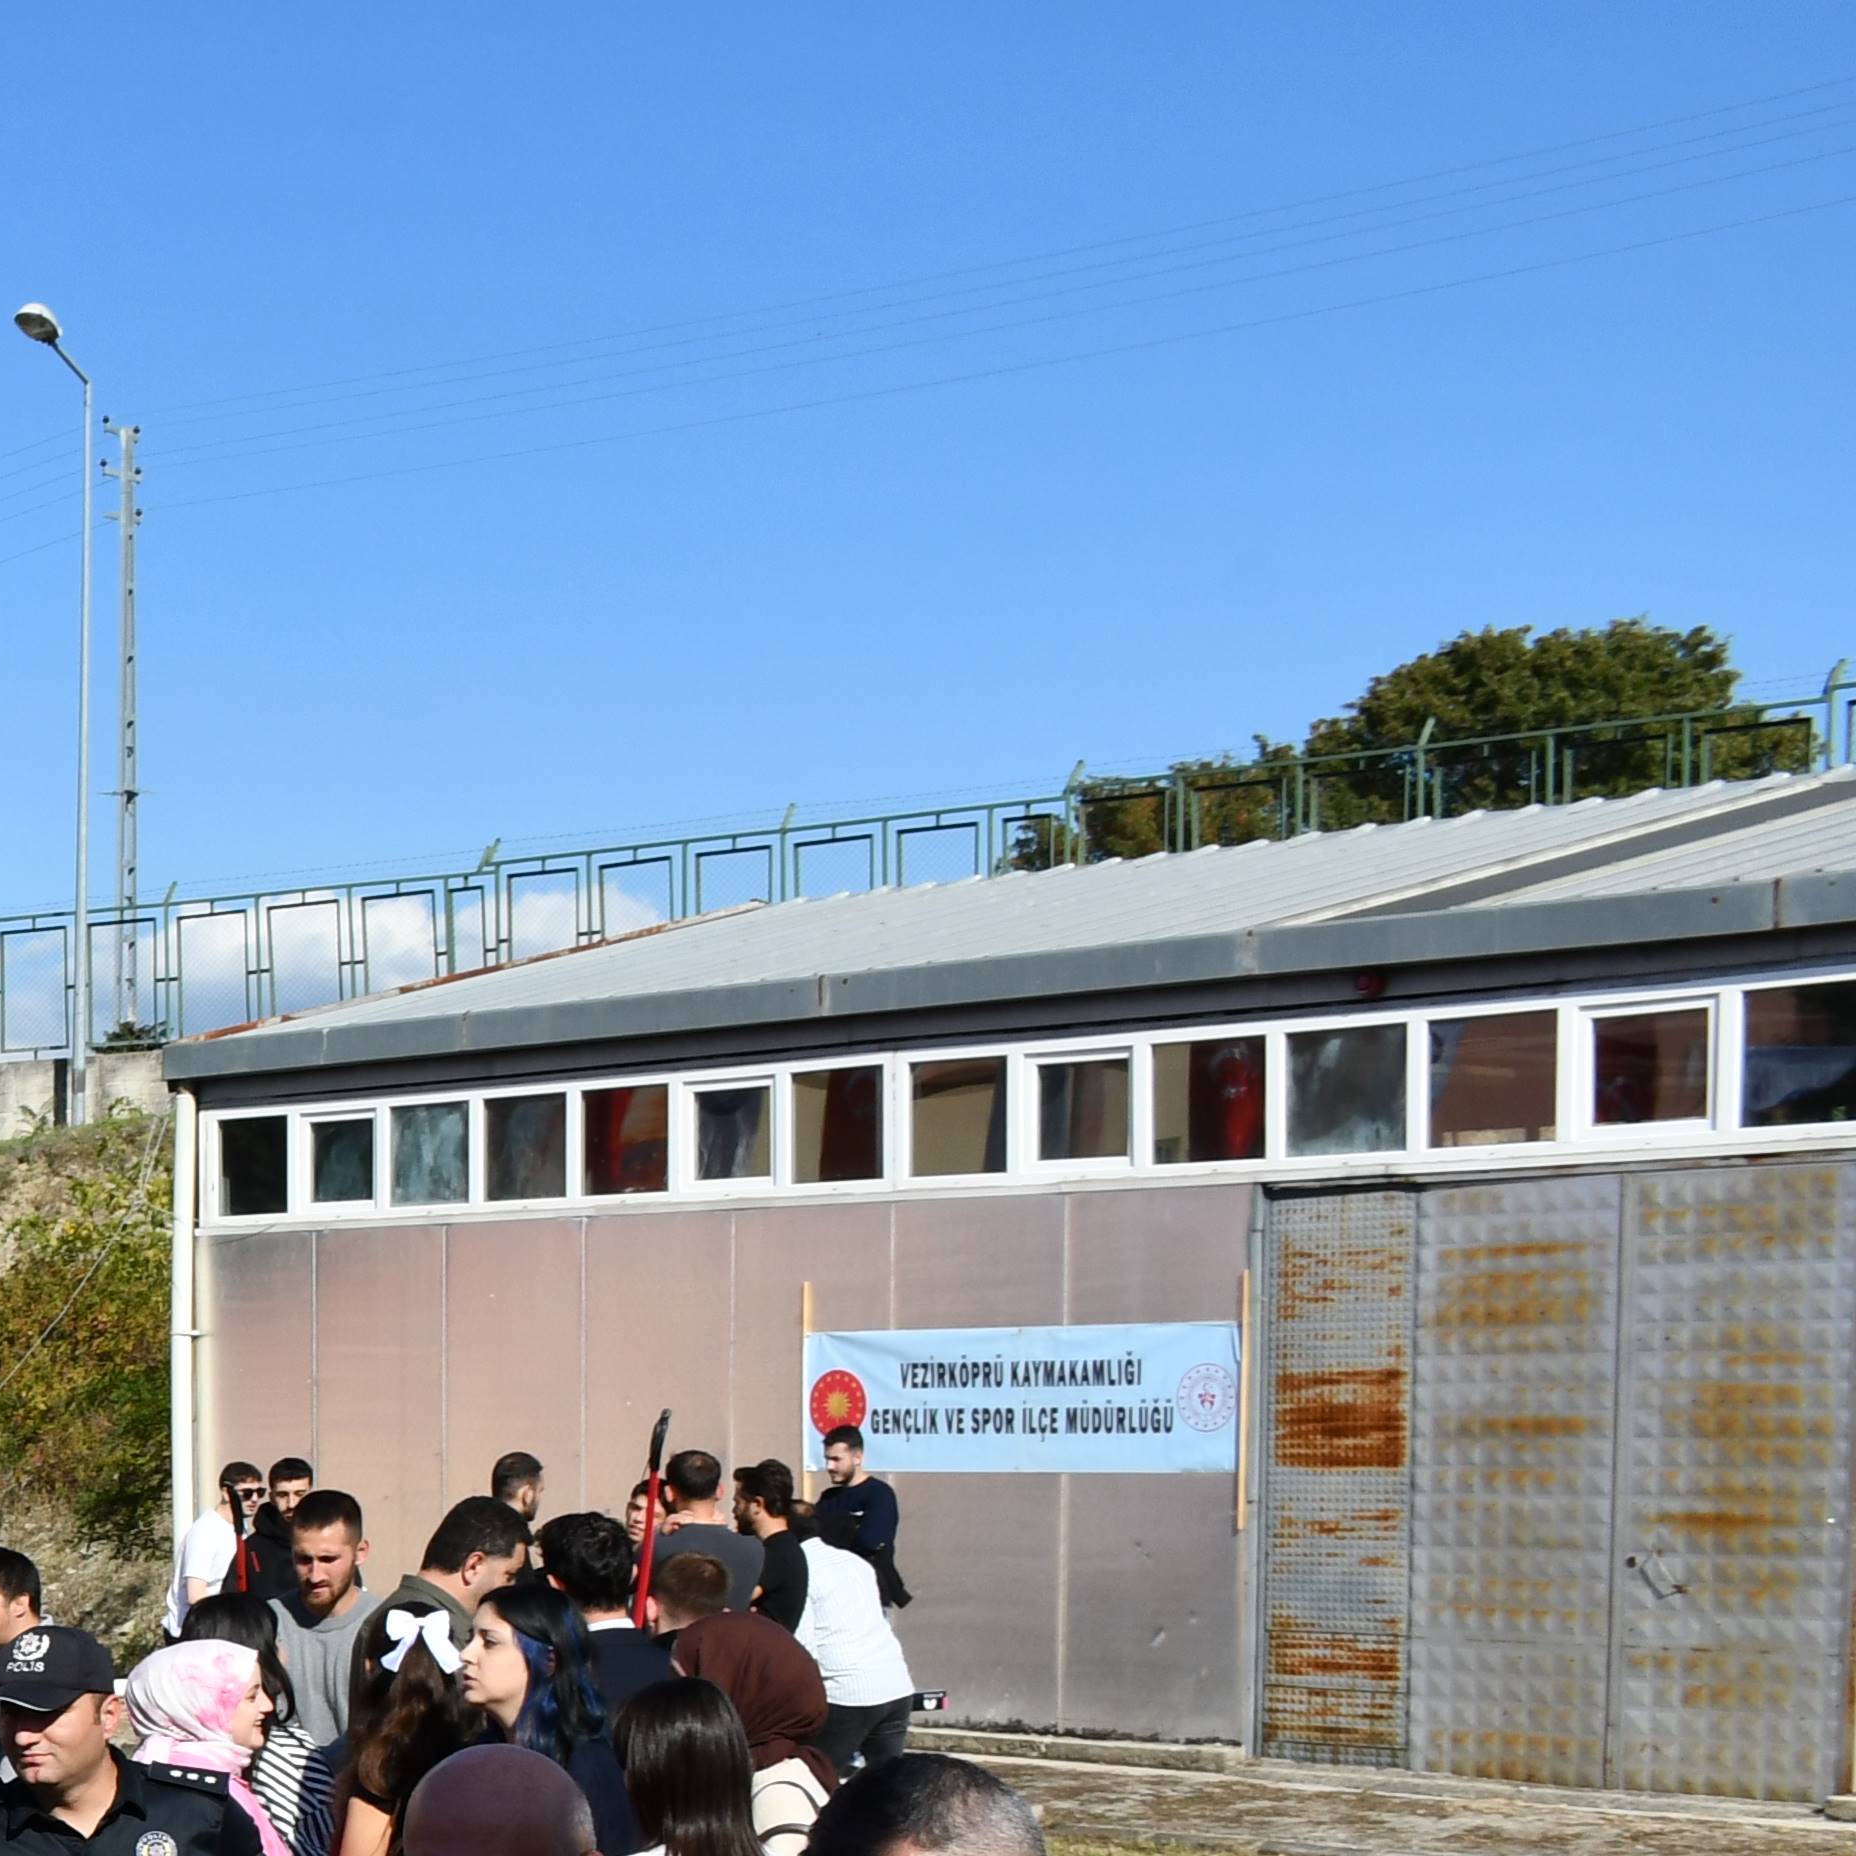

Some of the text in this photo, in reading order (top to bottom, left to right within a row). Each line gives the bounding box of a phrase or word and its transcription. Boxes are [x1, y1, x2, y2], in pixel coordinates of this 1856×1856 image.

[900, 1351, 1142, 1389] VEZİRKÖPRÜ KAYMAKAMLIĞI
[871, 1398, 1174, 1442] GENÇLİK VE SPOR İLÇE MÜDÜRLÜĞÜ
